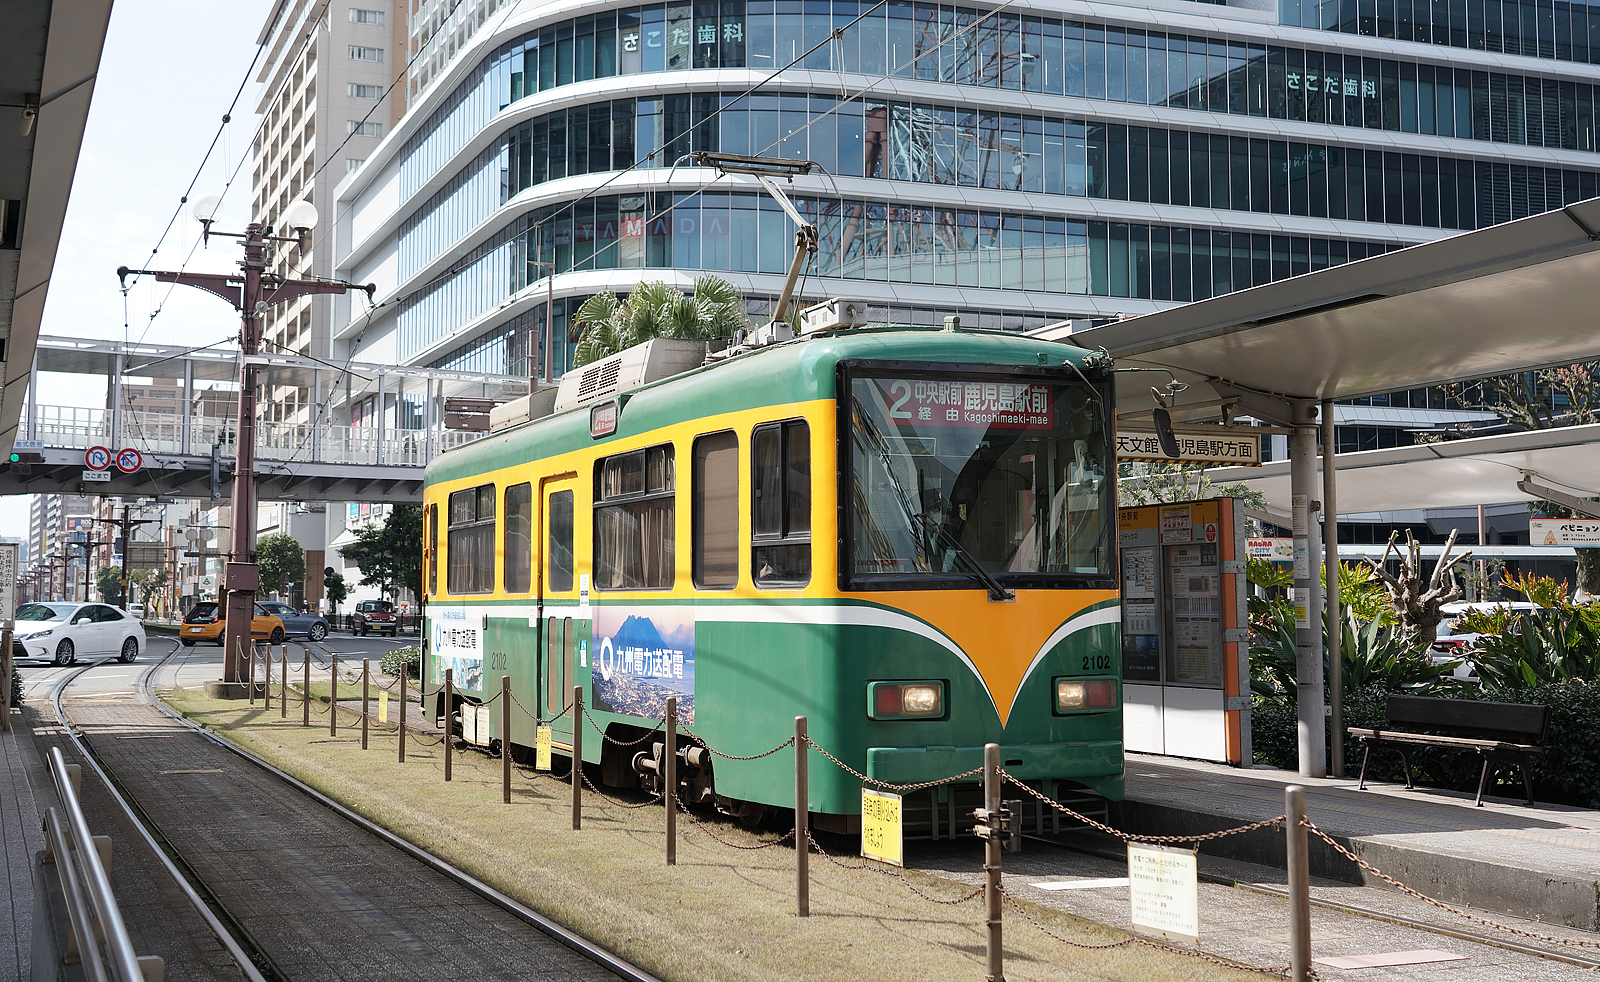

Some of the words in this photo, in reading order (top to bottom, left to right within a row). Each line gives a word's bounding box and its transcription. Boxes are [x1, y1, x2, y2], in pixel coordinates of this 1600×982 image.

[623, 22, 743, 53] さこだ歯科
[1287, 72, 1376, 99] さこだ歯科
[582, 217, 723, 241] YAMADA
[889, 379, 912, 419] 2
[914, 382, 962, 406] 中央駅前
[964, 384, 1048, 414] 鹿児島駅前
[964, 412, 1048, 425] Kagoshimaeki-mae
[1117, 436, 1159, 454] 天文館
[491, 651, 507, 671] 2102
[616, 645, 684, 680] 九州電力送配電
[1082, 655, 1111, 671] 2102
